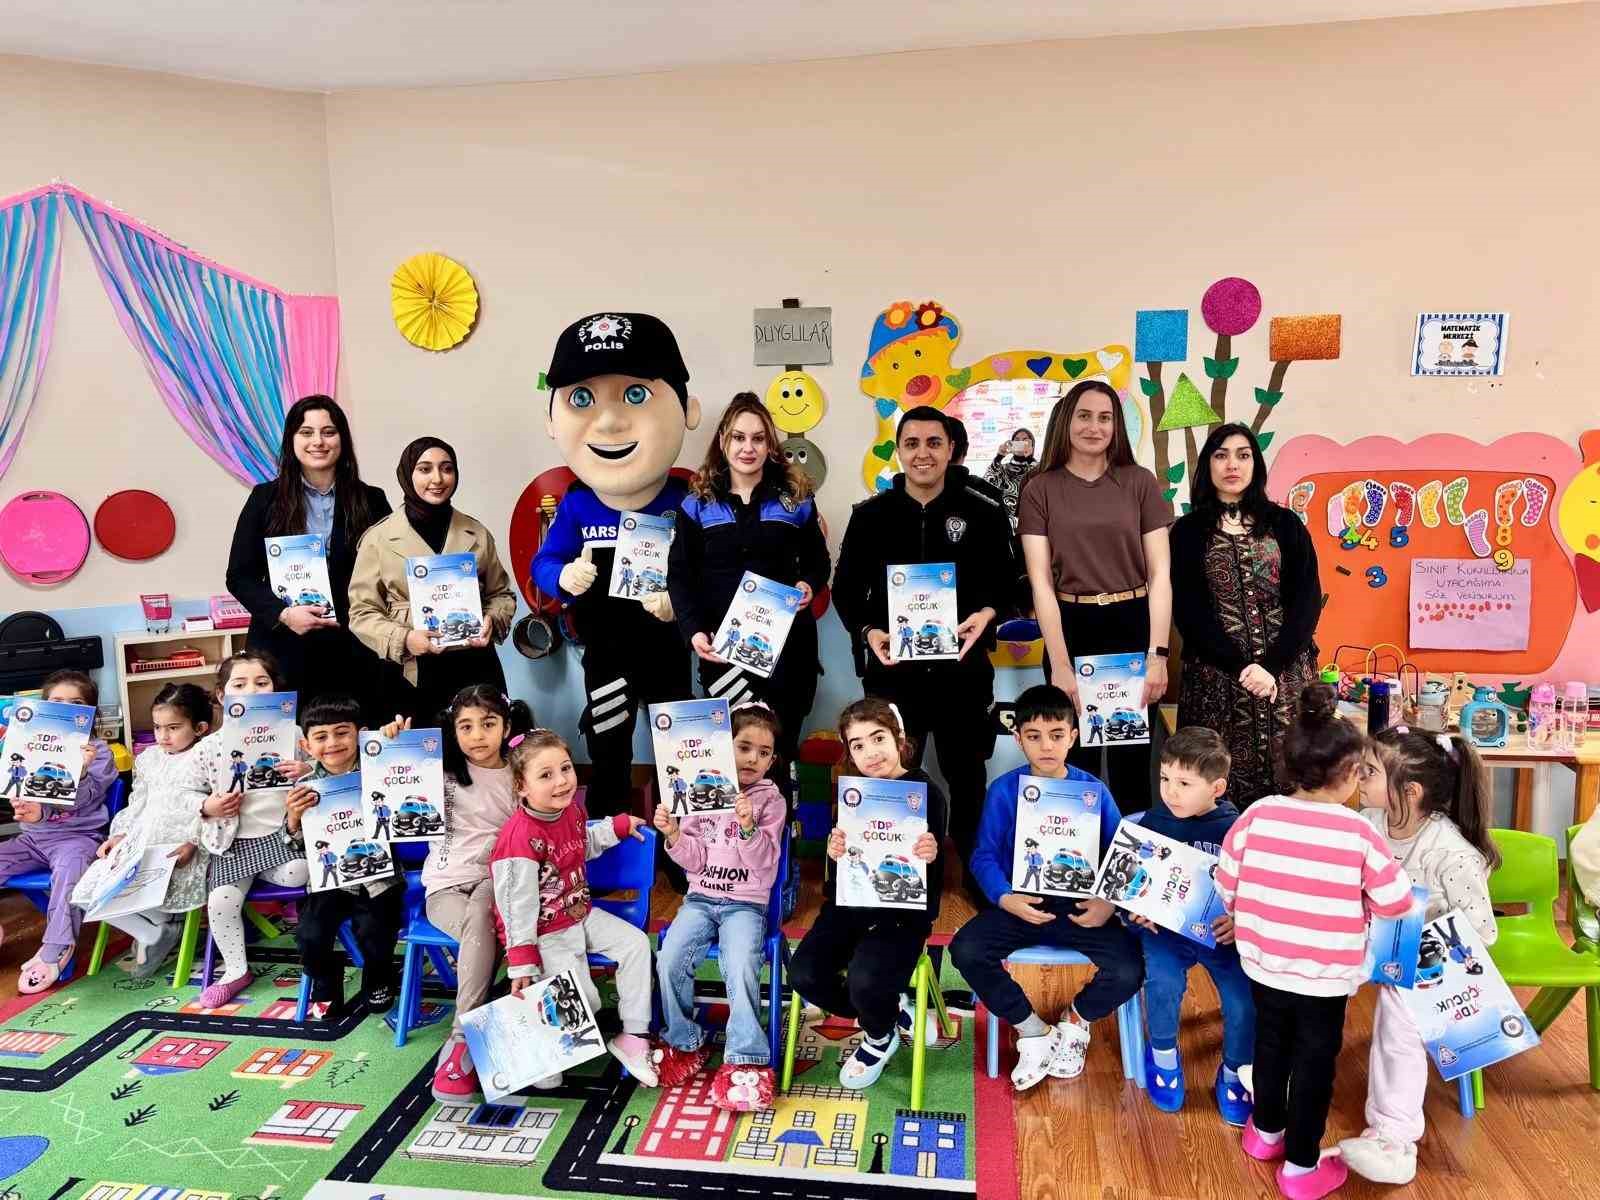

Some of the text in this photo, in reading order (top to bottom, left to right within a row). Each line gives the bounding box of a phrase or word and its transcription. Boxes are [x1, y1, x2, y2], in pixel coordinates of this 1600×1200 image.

[755, 321, 830, 350] DUYGULAR
[582, 525, 617, 539] KARS
[1360, 529, 1378, 551] 4
[1390, 526, 1409, 548] 5
[1493, 548, 1514, 571] 9
[1365, 566, 1387, 588] 3
[27, 743, 63, 753] ÇOCUK
[244, 735, 275, 746] ÇOCUK
[384, 776, 421, 787] ÇOCUK
[326, 818, 363, 834] ÇOCUK
[1039, 825, 1076, 837] ÇOCUK
[863, 831, 902, 842] ÇOCUK
[1437, 985, 1481, 1013] ÇOCUK
